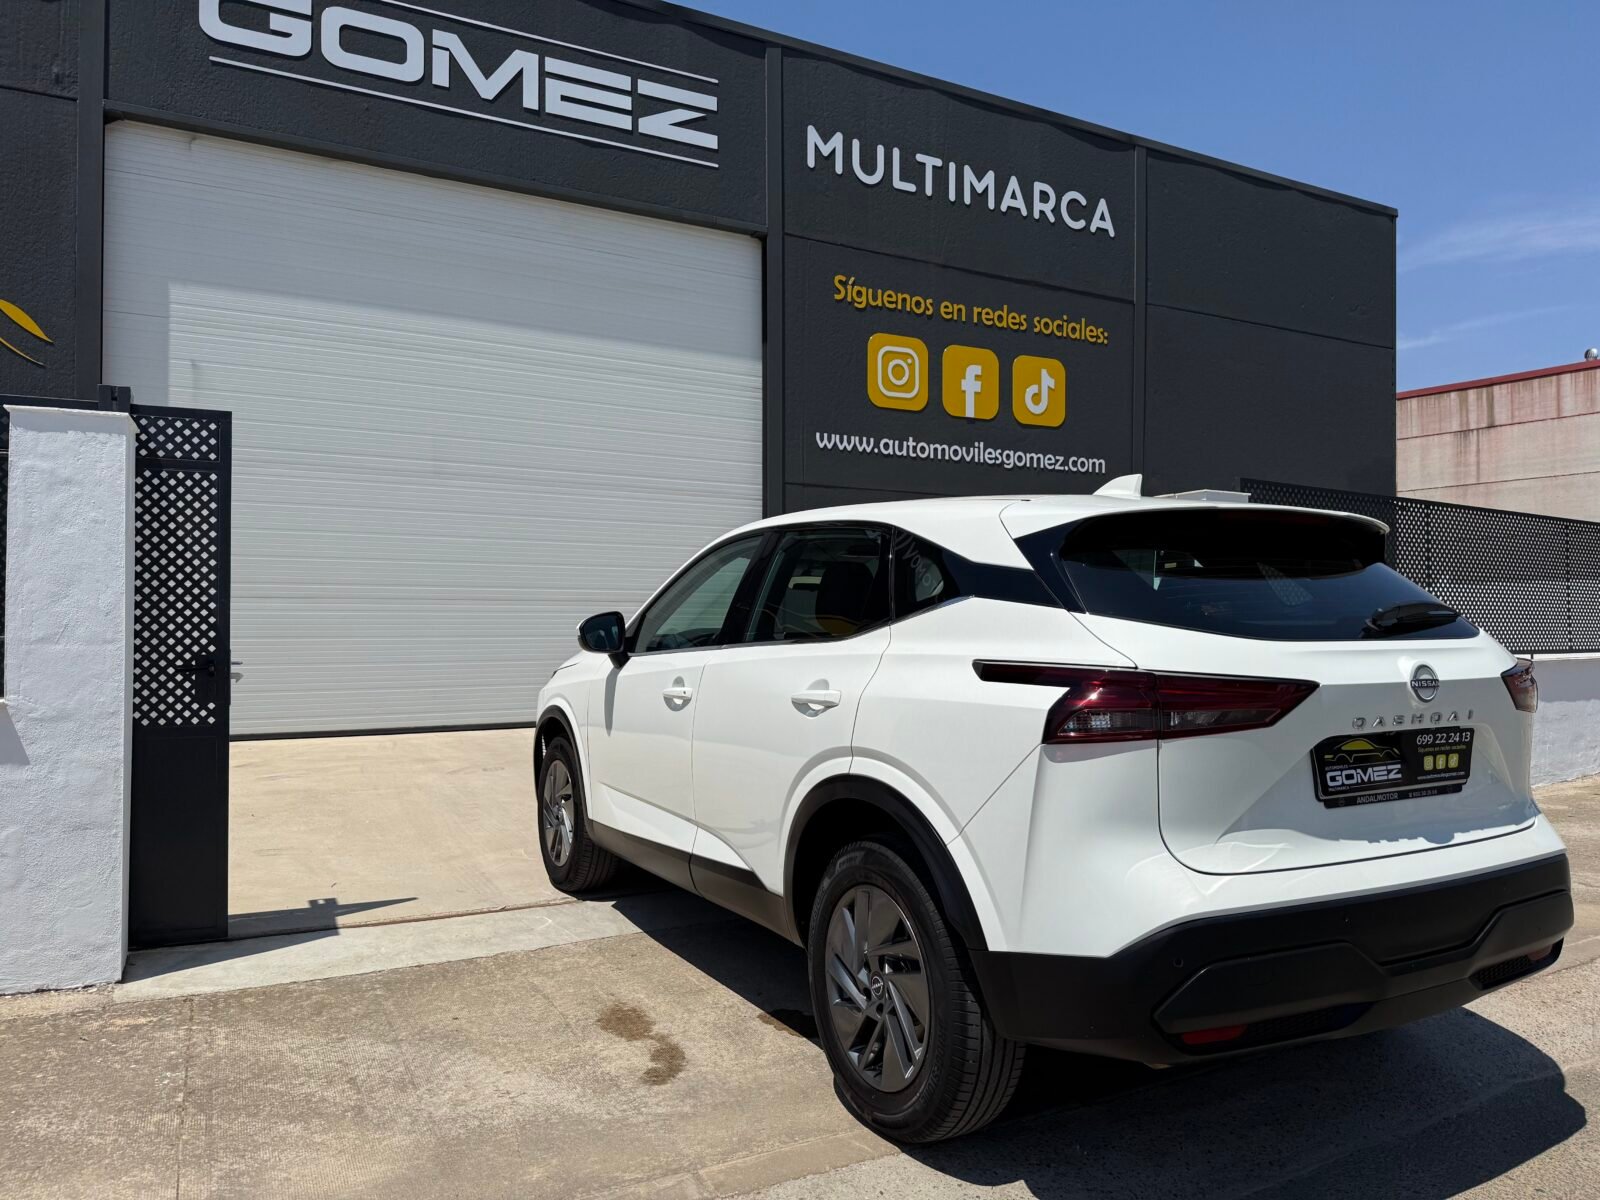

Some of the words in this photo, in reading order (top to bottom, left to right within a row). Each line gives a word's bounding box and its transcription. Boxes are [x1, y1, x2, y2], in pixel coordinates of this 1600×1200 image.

[198, 0, 718, 150] GOMEZ
[806, 125, 1116, 238] MULTIMARCA
[833, 274, 933, 316] Síguenos
[940, 301, 966, 322] en
[973, 303, 1028, 332] redes
[1033, 314, 1109, 345] sociales:
[815, 431, 1106, 474] www.automovilesgomez.com
[1352, 709, 1474, 730] QASHQAI
[1416, 734, 1434, 745] 699
[1435, 733, 1447, 744] 22
[1448, 732, 1460, 743] 24
[1462, 731, 1471, 742] 13
[1326, 764, 1402, 787] GOMEZ
[1356, 792, 1399, 804] ANDALMOTOR
